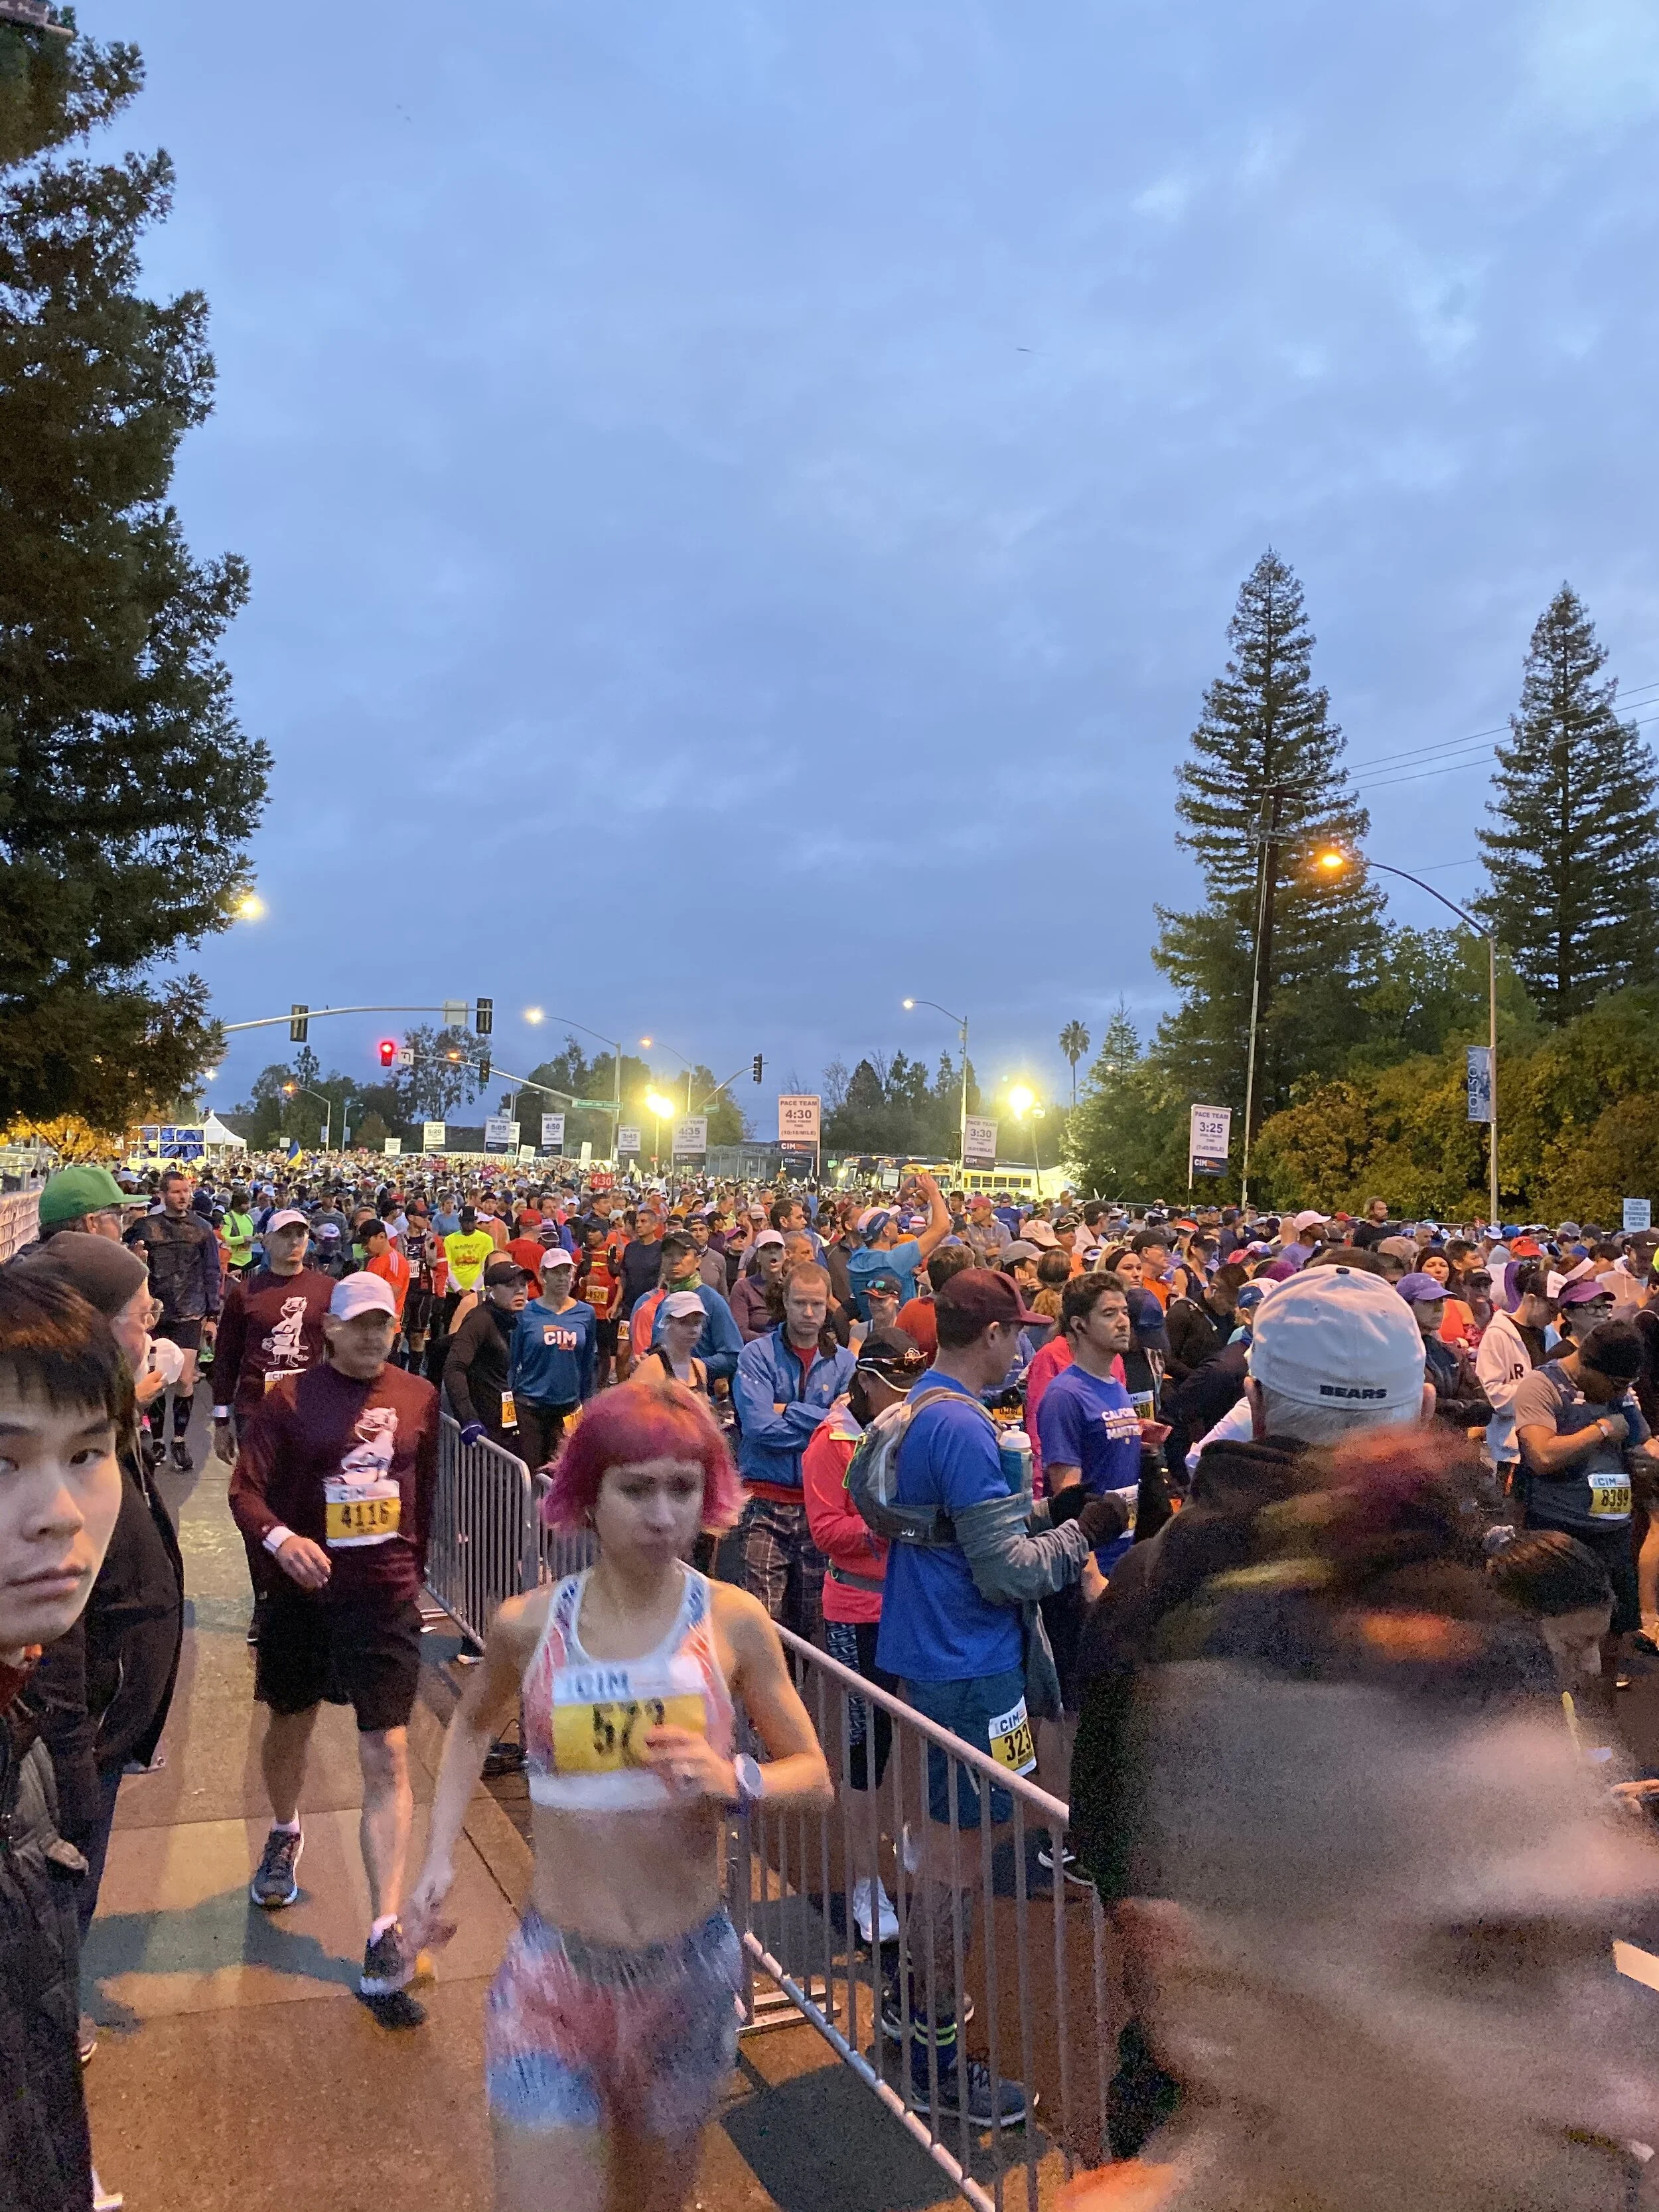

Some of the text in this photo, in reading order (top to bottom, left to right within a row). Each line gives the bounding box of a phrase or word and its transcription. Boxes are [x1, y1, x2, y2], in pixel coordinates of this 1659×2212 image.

[1468, 1051, 1479, 1116] FOLSOM
[785, 1110, 812, 1119] 4:30
[970, 1129, 992, 1138] 3:30
[1199, 1122, 1223, 1134] 3:25
[593, 1177, 612, 1186] 4:30
[544, 1331, 577, 1345] CIM
[1320, 1385, 1387, 1399] BEARS
[1601, 1489, 1628, 1507] 8399
[341, 1501, 389, 1528] 4116
[1000, 1712, 1020, 1732] CIM
[1005, 1724, 1031, 1761] 323
